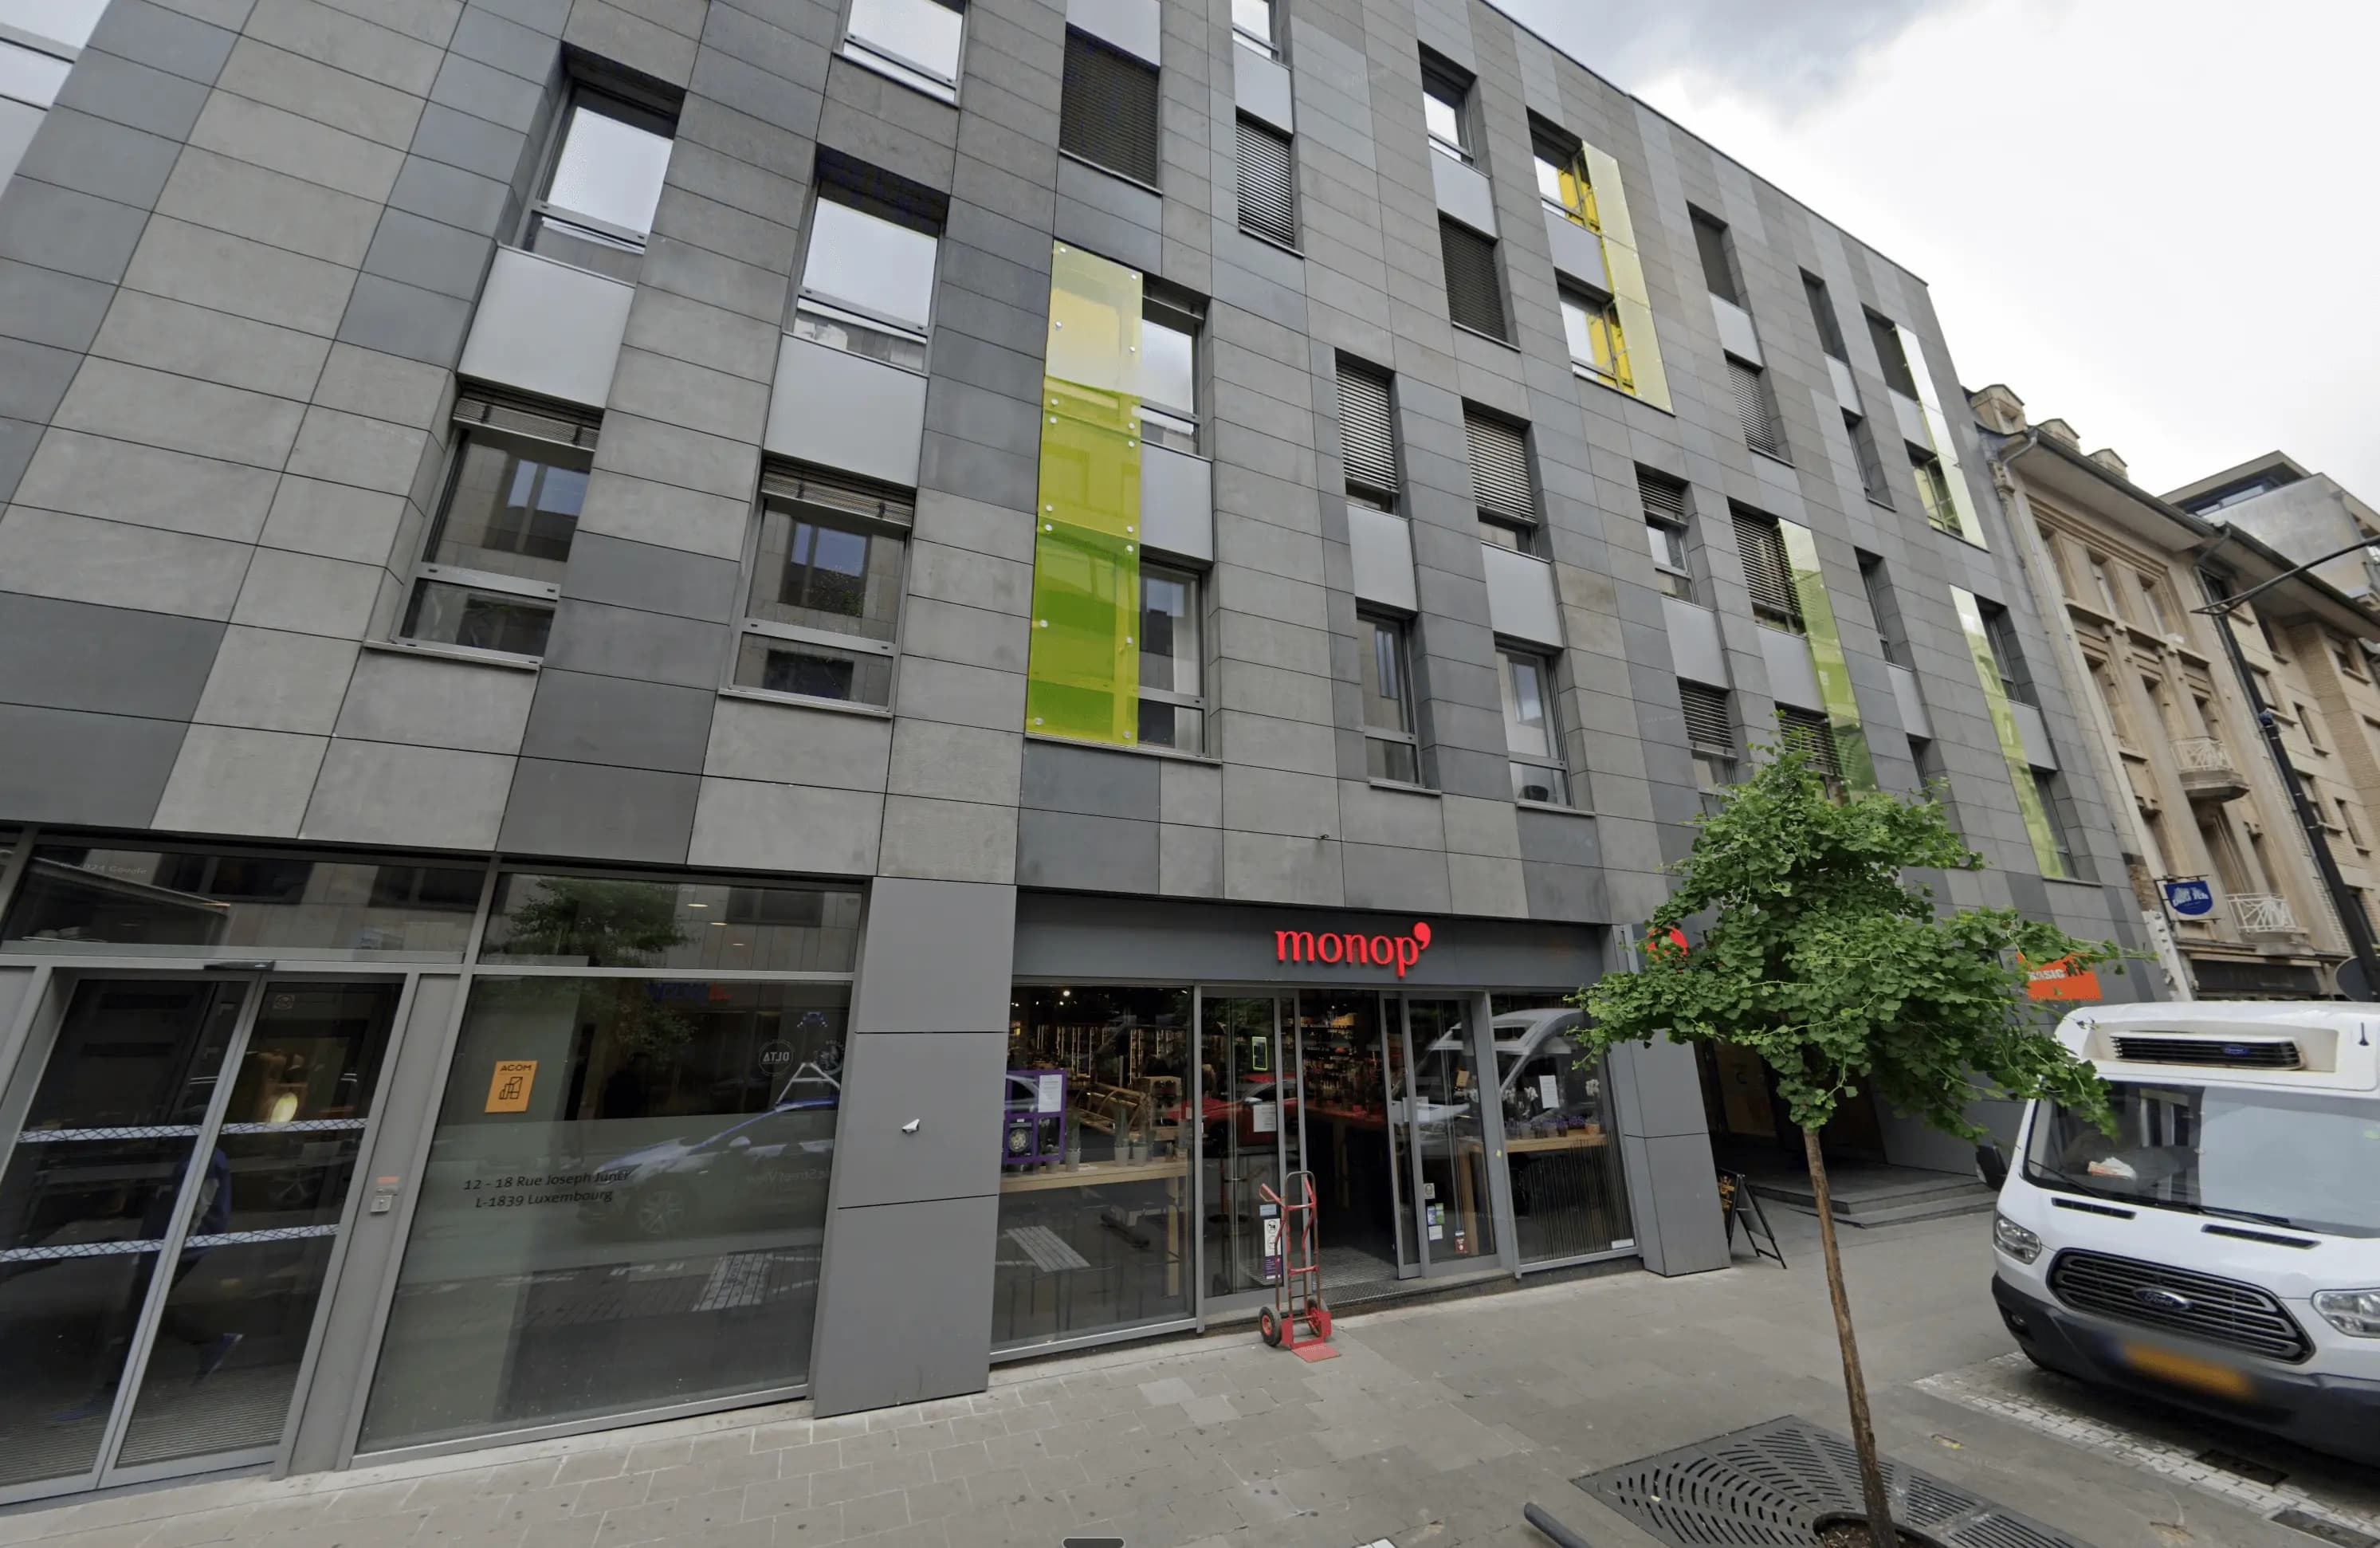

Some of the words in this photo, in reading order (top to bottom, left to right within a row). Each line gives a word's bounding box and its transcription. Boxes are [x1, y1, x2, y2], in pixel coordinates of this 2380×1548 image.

[463, 1179, 481, 1191] 12
[495, 1177, 513, 1189] 18
[516, 1176, 543, 1187] Rue
[545, 1172, 591, 1188] Joseph
[475, 1195, 524, 1208] L-1839
[527, 1190, 613, 1205] Luxembourg
